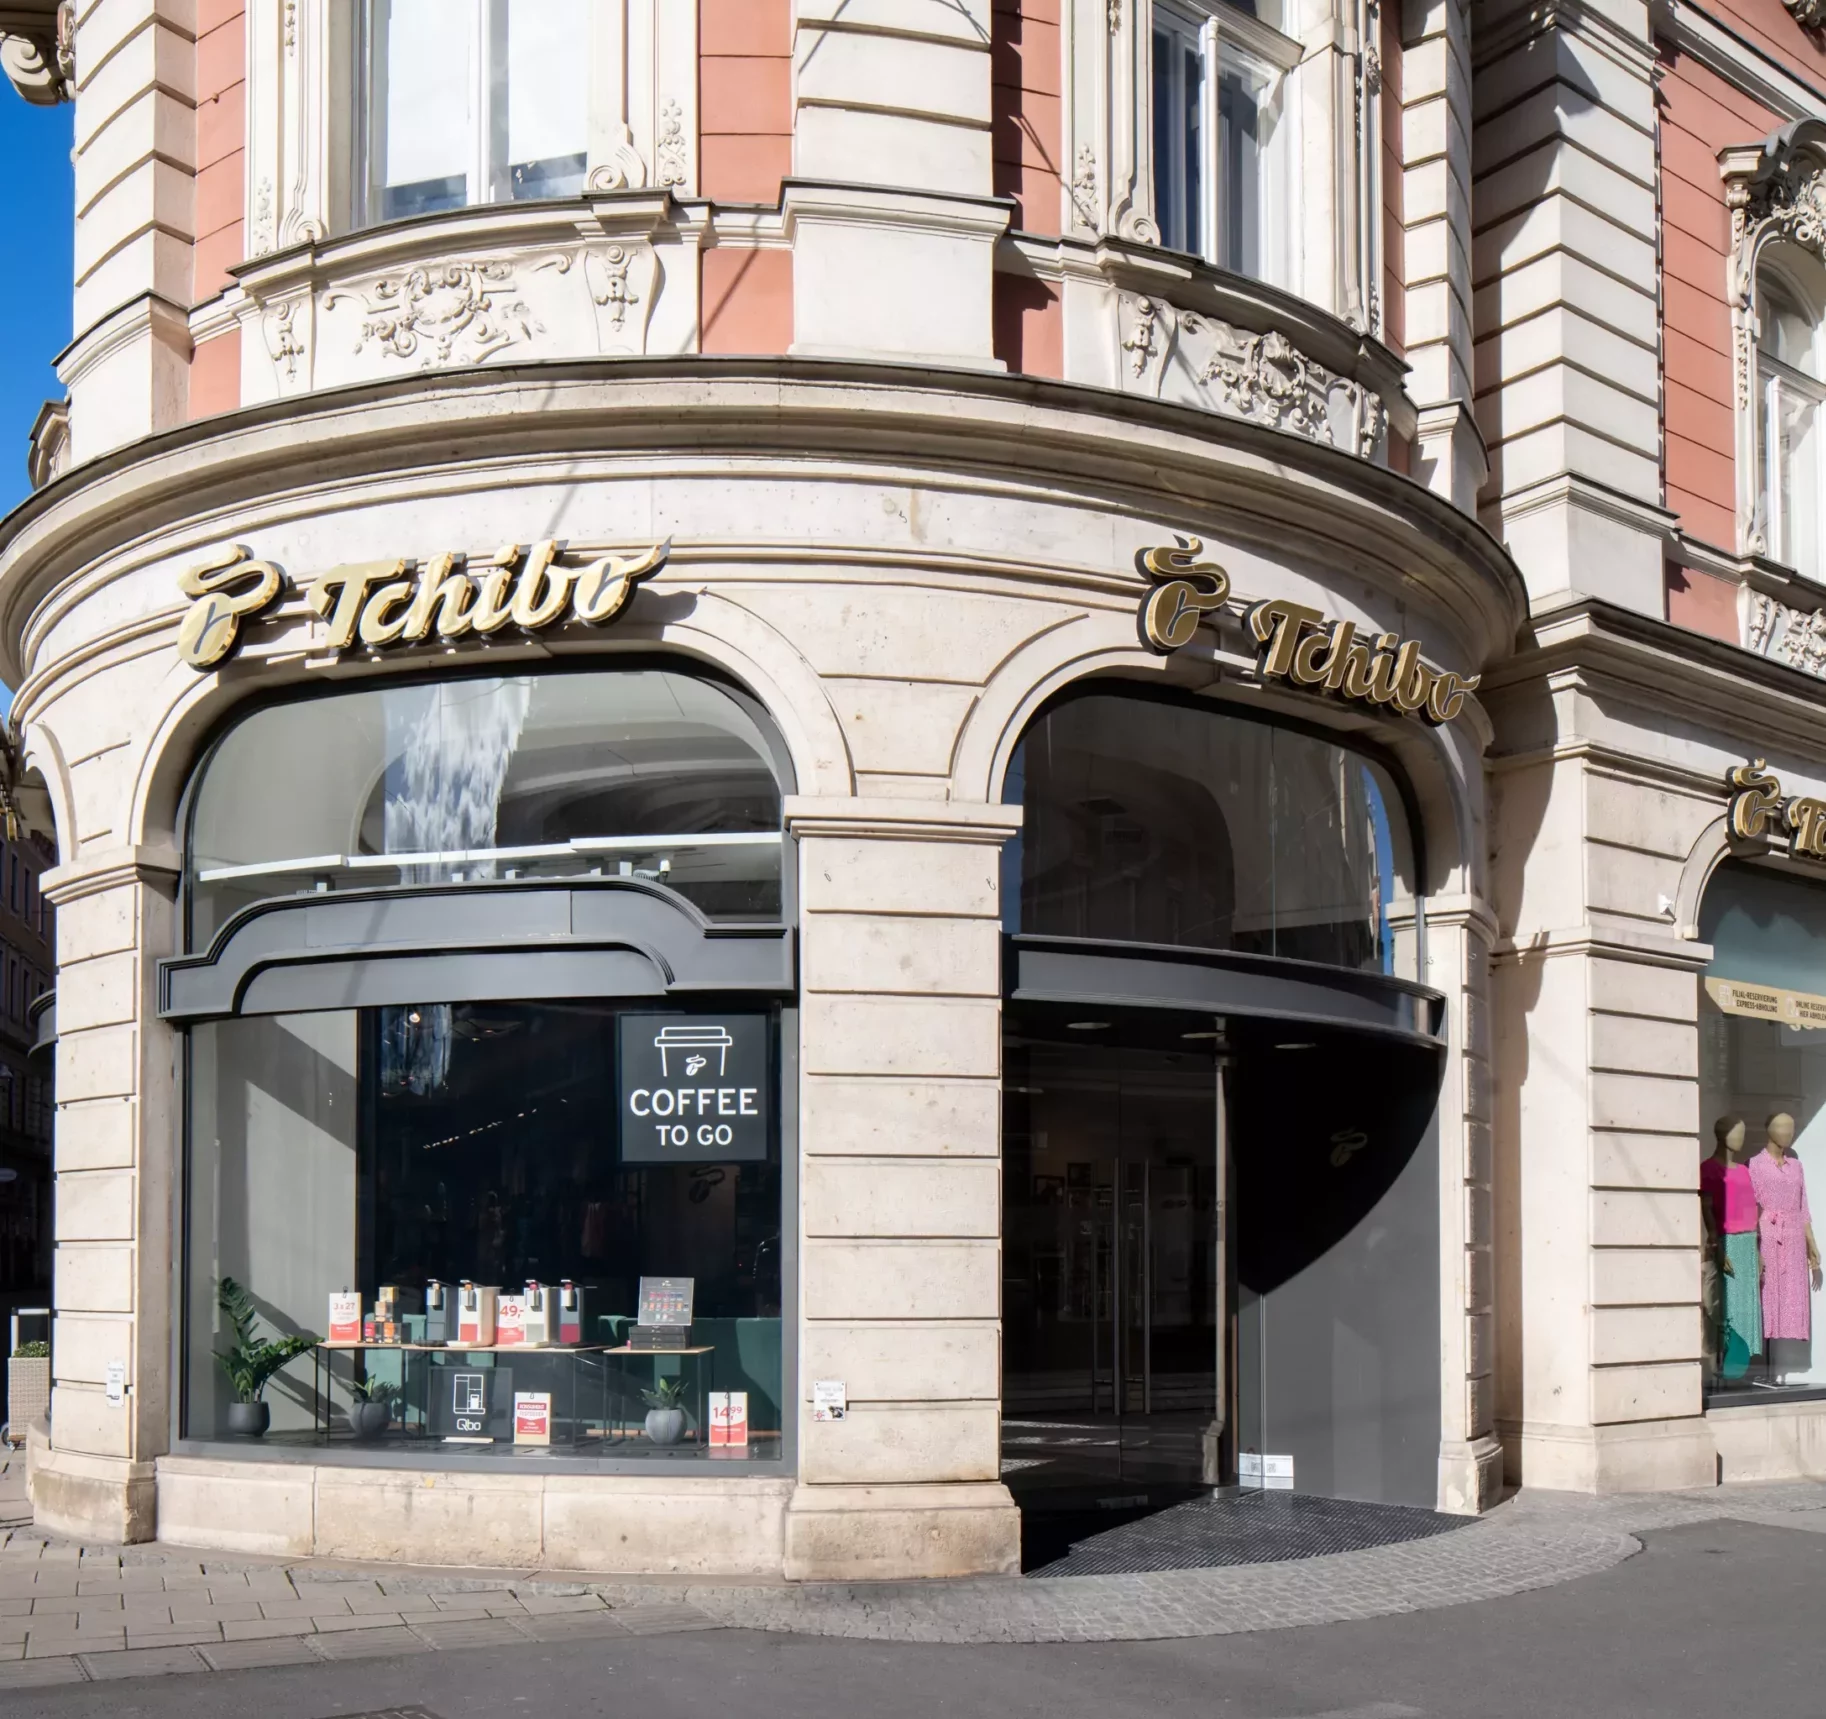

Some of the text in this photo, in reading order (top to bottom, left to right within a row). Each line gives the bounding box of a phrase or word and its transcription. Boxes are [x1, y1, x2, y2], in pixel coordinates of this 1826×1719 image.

[307, 536, 668, 649] Tchibo
[1250, 599, 1482, 722] Tchibo
[630, 1088, 758, 1116] COFFEE
[655, 1124, 733, 1146] TO GO
[457, 1418, 481, 1431] Qbo
